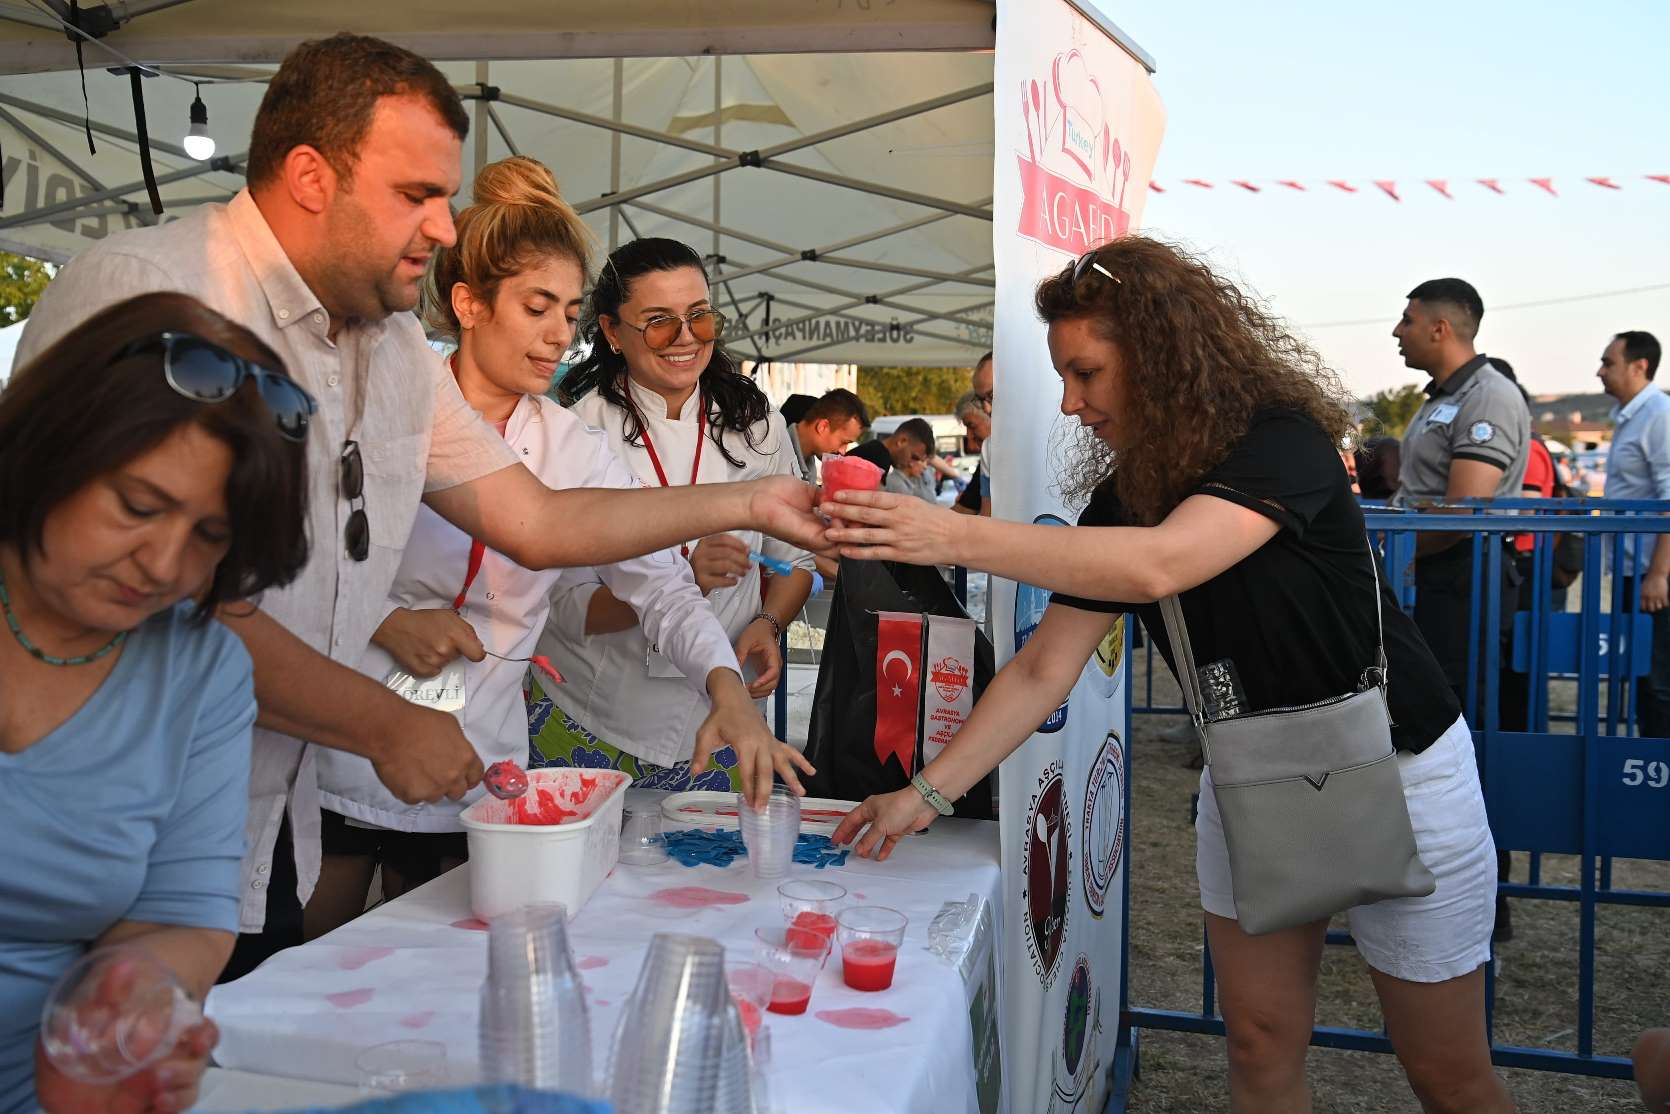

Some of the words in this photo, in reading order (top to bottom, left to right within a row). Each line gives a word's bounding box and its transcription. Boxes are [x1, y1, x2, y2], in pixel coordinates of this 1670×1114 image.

[1067, 119, 1094, 160] Turkey
[1622, 758, 1669, 788] 59
[1022, 794, 1037, 875] AVRASYA
